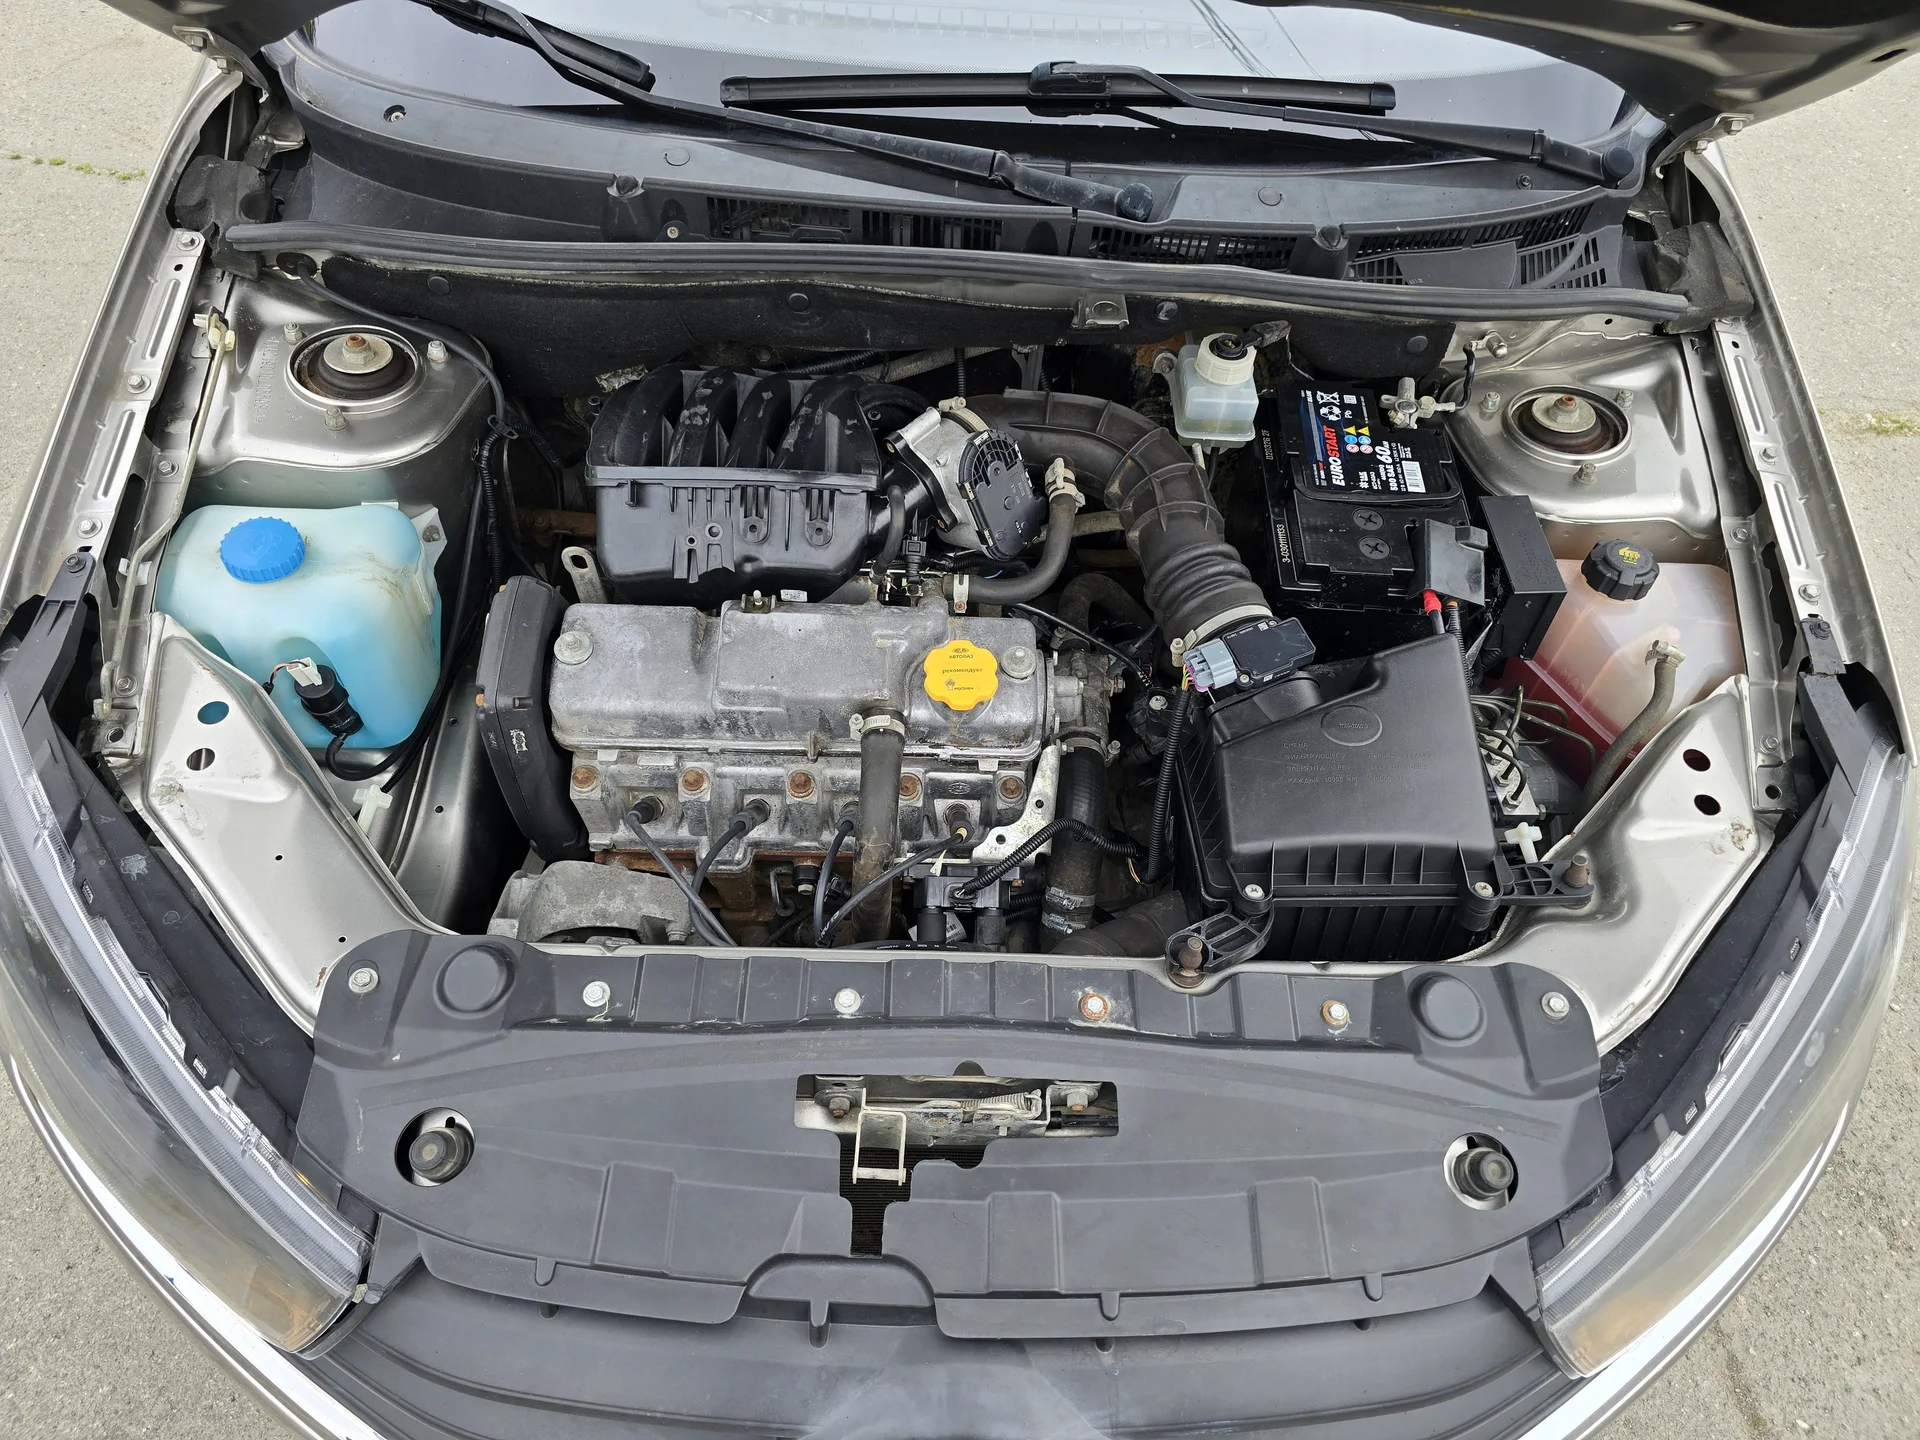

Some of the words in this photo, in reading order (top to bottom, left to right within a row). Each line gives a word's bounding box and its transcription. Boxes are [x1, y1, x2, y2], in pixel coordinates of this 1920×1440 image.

[1323, 425, 1346, 487] EUROSTART
[1385, 464, 1396, 478] SAE
[1388, 477, 1399, 491] 500
